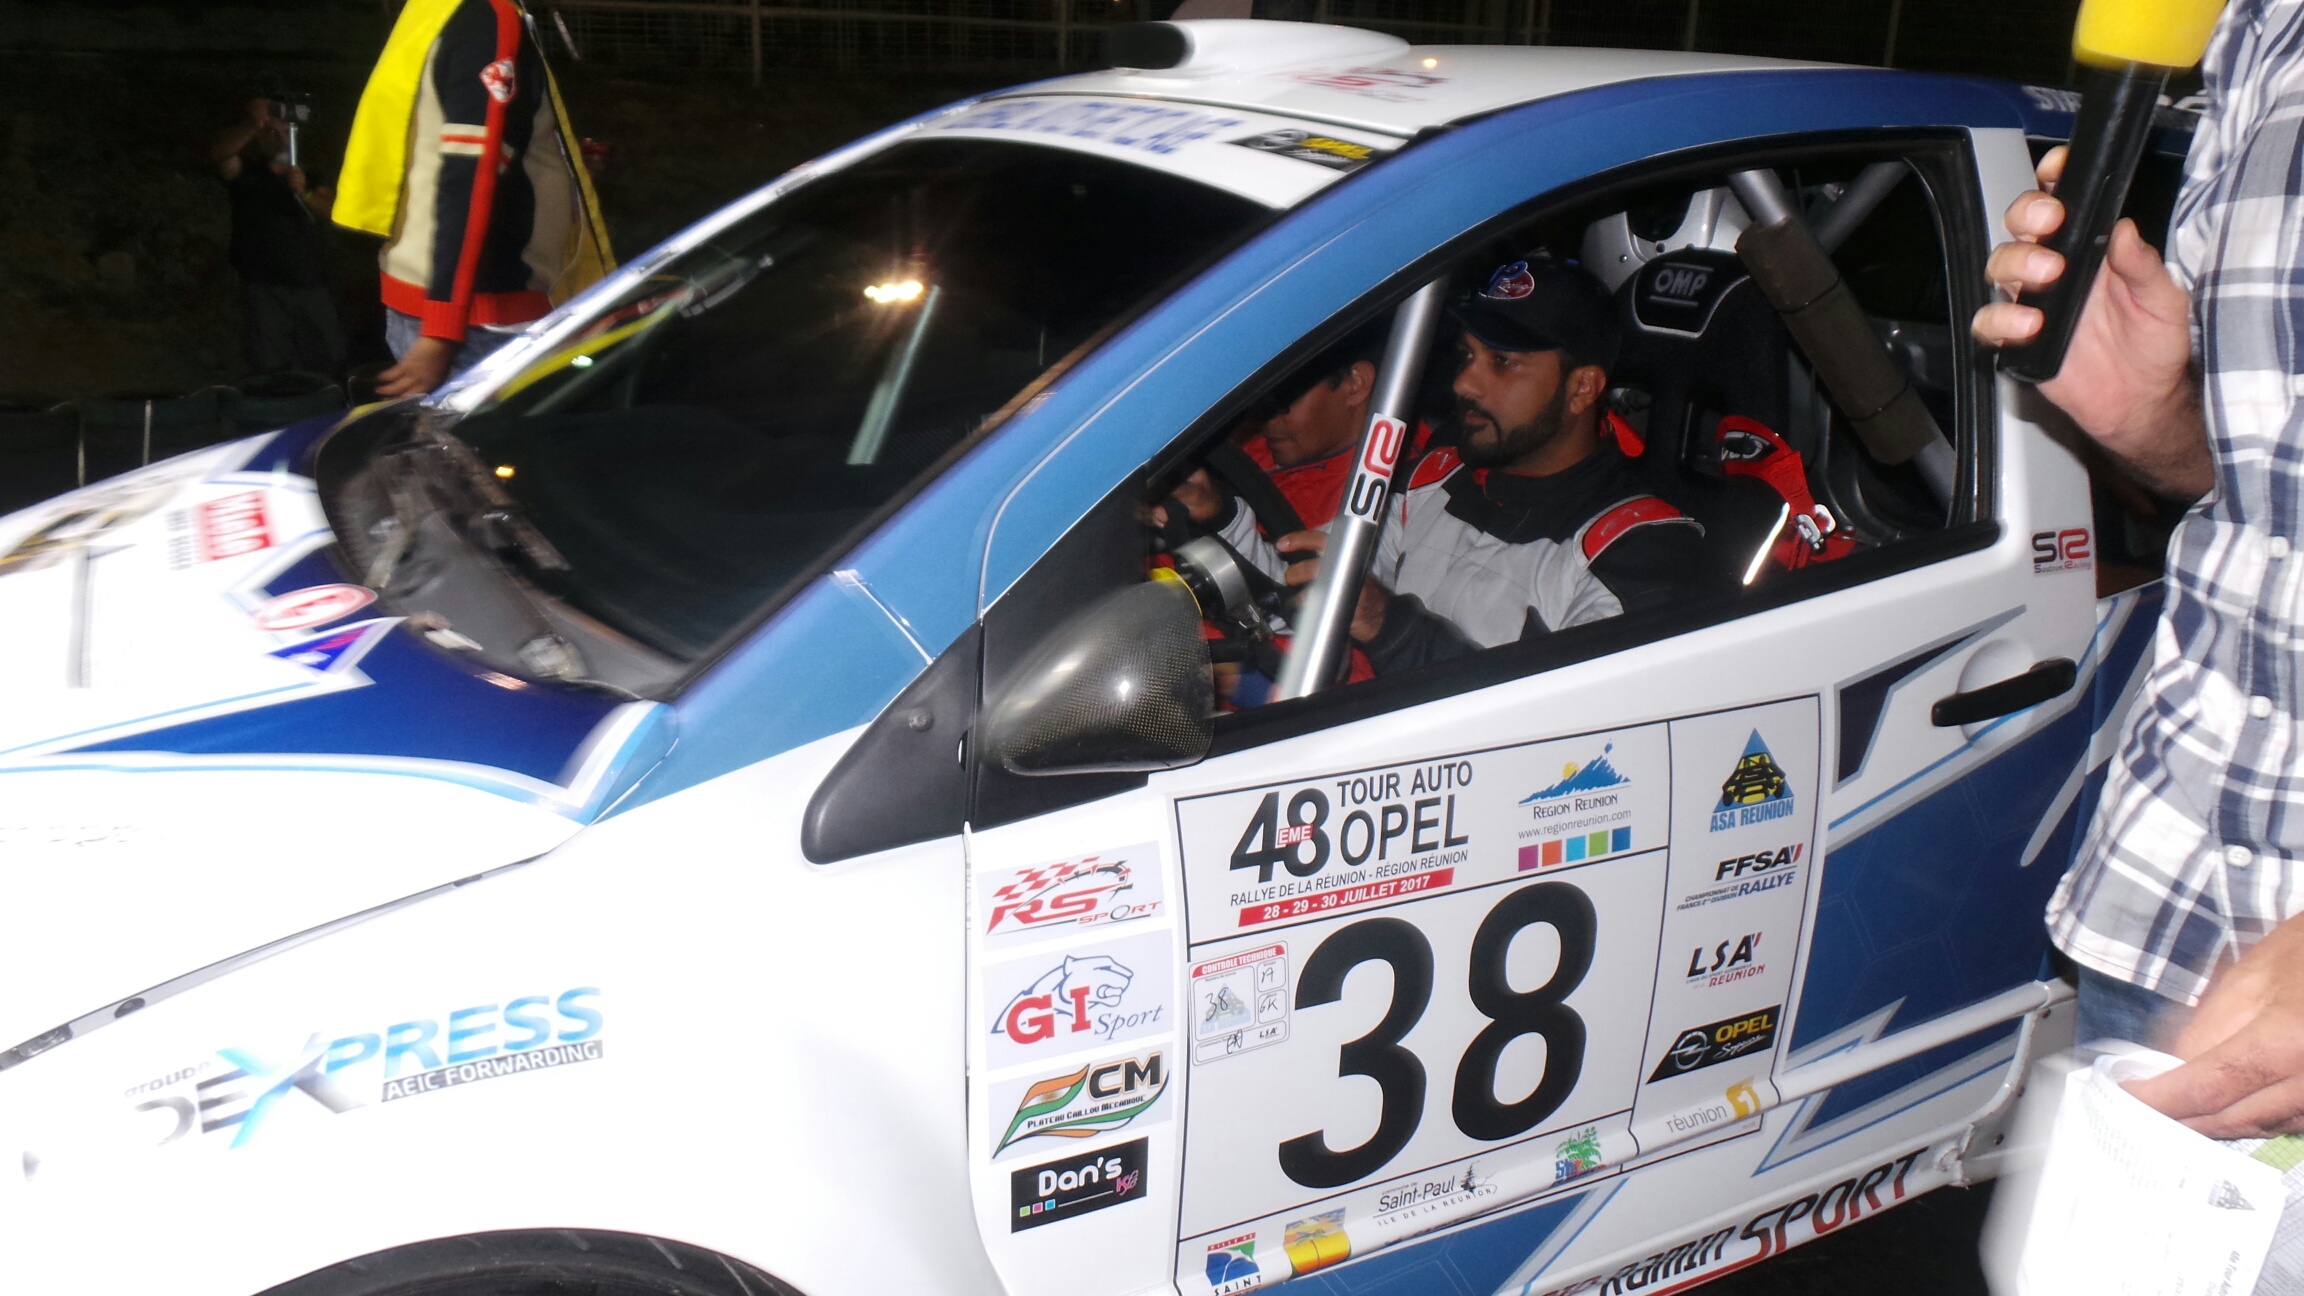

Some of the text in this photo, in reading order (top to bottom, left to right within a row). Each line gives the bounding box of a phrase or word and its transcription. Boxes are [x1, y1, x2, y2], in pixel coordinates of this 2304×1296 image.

[1655, 268, 1707, 296] OMP
[1337, 760, 1473, 807] TOUR AUTO
[1340, 794, 1469, 867] OPEL
[1518, 809, 1632, 839] www.regionreunion.com
[1709, 799, 1795, 833] ASA REUNION
[1229, 787, 1331, 884] 48
[1278, 825, 1312, 845] EME
[1230, 885, 1276, 907] RALLYE
[1279, 882, 1295, 898] DE
[1298, 879, 1313, 893] LA
[1316, 868, 1367, 890] RÉUNION
[1375, 858, 1418, 879] RÉGION
[1420, 850, 1469, 870] RÉUNION
[1715, 845, 1795, 882] FFSA
[1263, 906, 1280, 920] 28
[1292, 900, 1309, 914] 29
[1321, 894, 1337, 908] 30
[1340, 881, 1397, 905] JUILLET
[1400, 875, 1431, 892] 2017
[1738, 871, 1795, 897] RALLYE
[986, 882, 1126, 936] RS
[1078, 901, 1162, 924] SPORT
[1202, 946, 1277, 975] CONTROLE TECHNIQUE
[1709, 964, 1766, 988] REUNION
[1205, 986, 1230, 1022] 38
[1094, 1004, 1164, 1041] Sport
[1278, 880, 1599, 1190] 38
[1716, 1014, 1773, 1042] OPEL
[386, 1041, 600, 1101] AEIC FORWARDING
[1666, 1105, 1728, 1134] réunion
[1038, 1157, 1123, 1198] Dan's
[1378, 1175, 1456, 1212] Saint-Paul
[1402, 1211, 1417, 1220] DE
[1423, 1205, 1437, 1213] LA
[1739, 1146, 1930, 1260] SPORT
[1210, 1238, 1239, 1251] VILLE
[1214, 1275, 1262, 1296] SAINT
